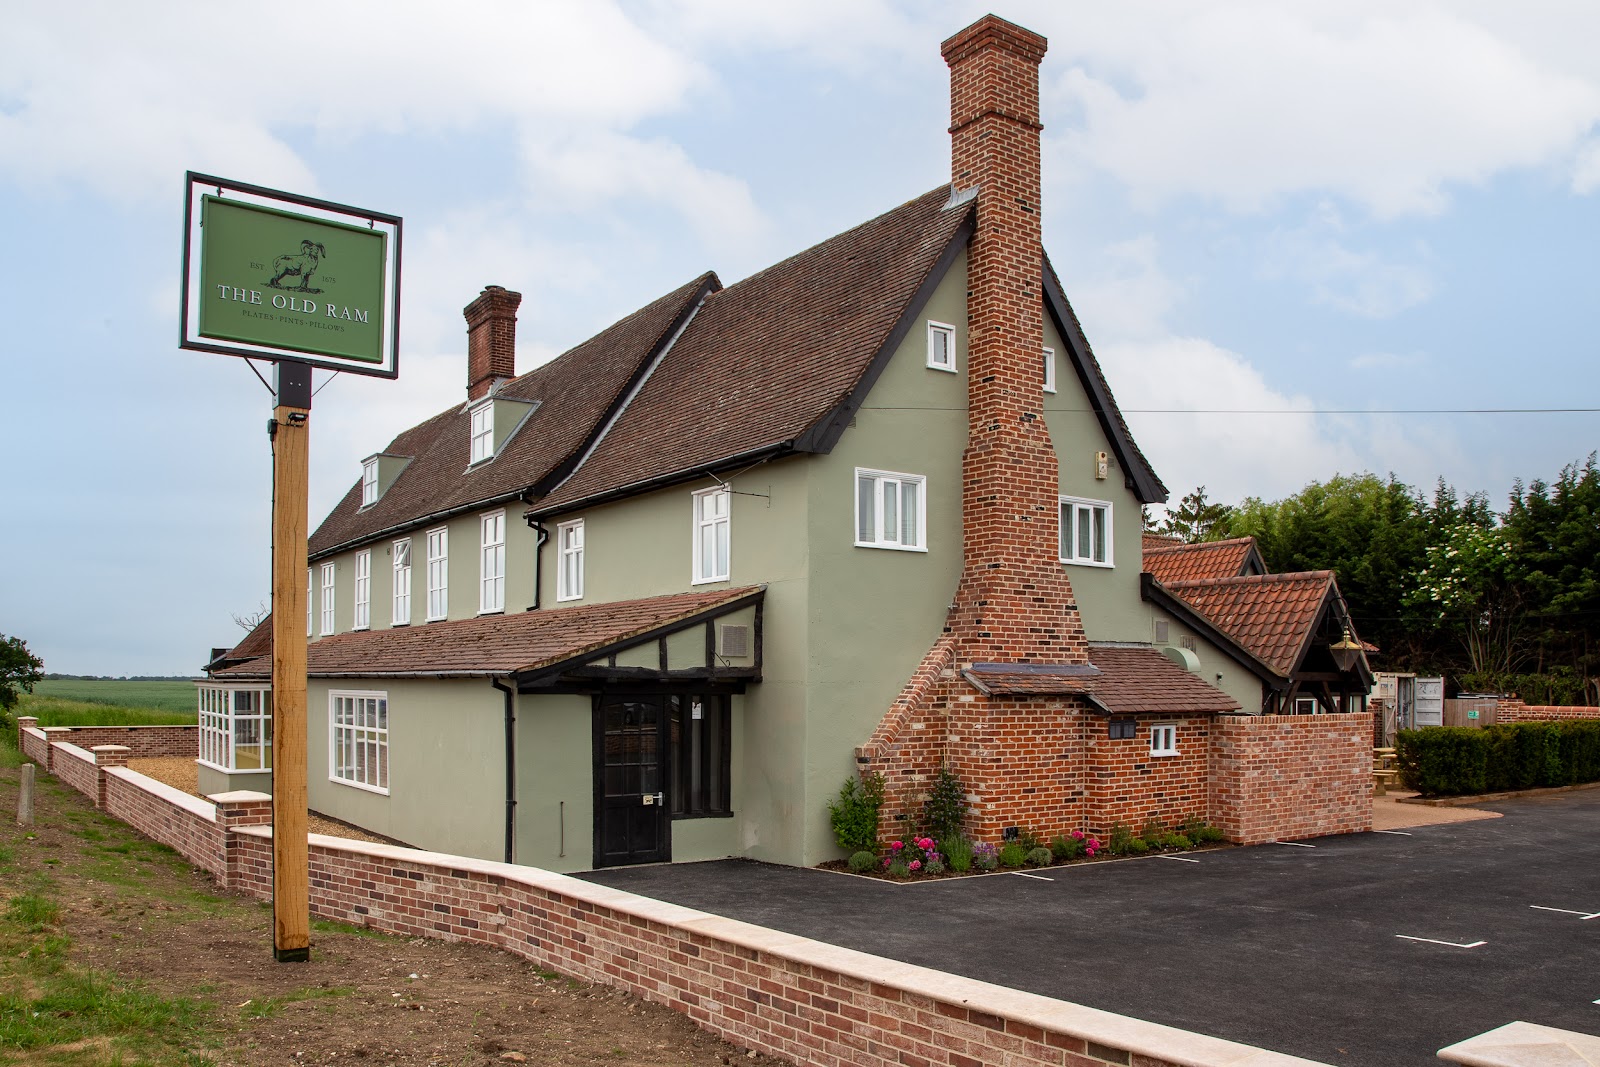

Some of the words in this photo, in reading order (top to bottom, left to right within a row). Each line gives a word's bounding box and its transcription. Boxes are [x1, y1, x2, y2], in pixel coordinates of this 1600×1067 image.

[322, 276, 336, 284] 1675
[217, 284, 262, 305] THE
[272, 295, 317, 314] OLD
[326, 303, 369, 323] RAM
[242, 310, 273, 321] PLATES
[279, 316, 304, 326] PINTS
[309, 322, 345, 332] PILLOWS
